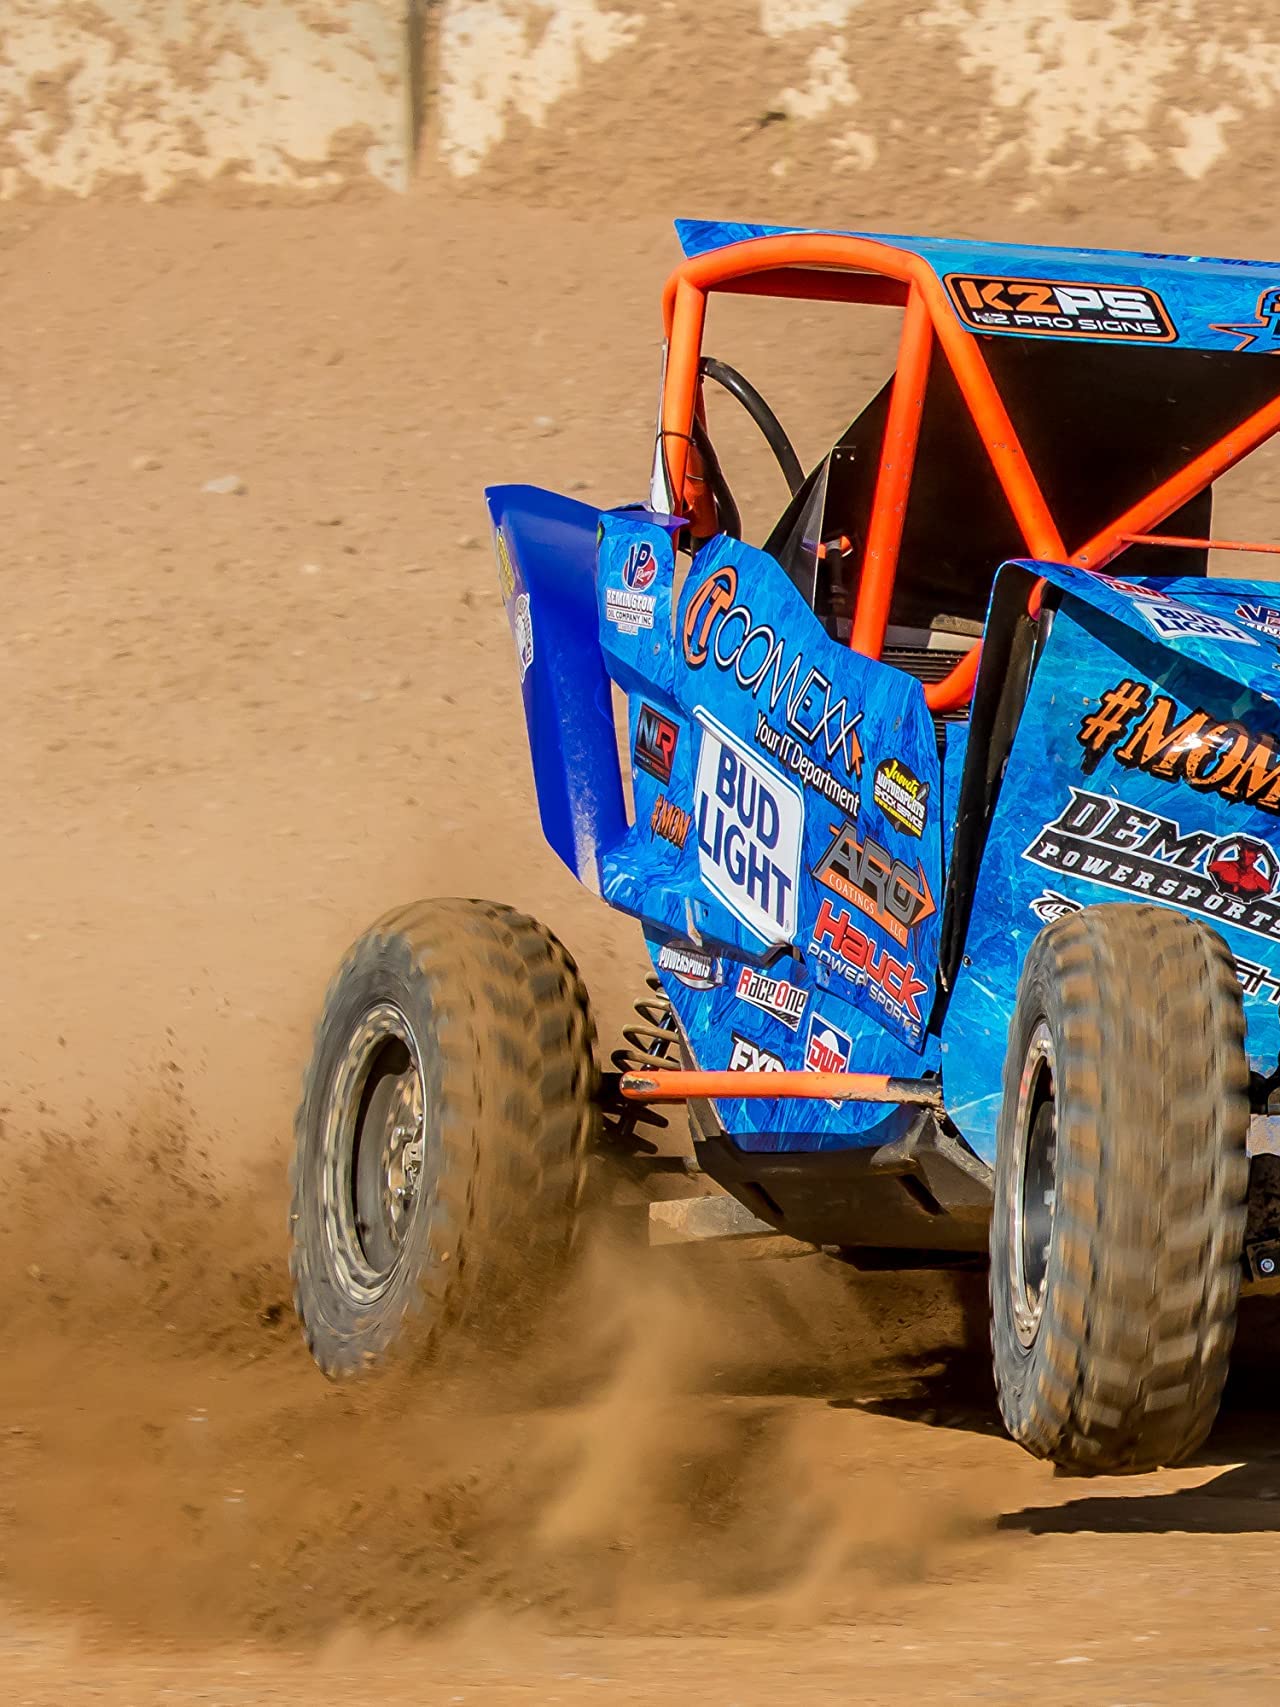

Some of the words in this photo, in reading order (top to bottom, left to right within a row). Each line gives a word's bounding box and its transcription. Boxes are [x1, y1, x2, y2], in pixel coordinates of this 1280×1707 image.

[959, 281, 1155, 320] K2PS
[1015, 314, 1073, 330] PRO
[1078, 319, 1162, 335] SIGNS
[627, 542, 652, 588] VP
[607, 589, 656, 612] REMINGTON
[616, 610, 641, 622] COMPANY
[1152, 607, 1221, 626] BUD
[1155, 618, 1246, 639] LIGHT
[638, 710, 677, 770] NLR
[755, 713, 780, 752] Your
[780, 734, 799, 762] IT
[793, 746, 860, 818] Department
[715, 744, 780, 850] BUD
[874, 784, 897, 809] SHOCK
[896, 801, 923, 831] SERVICE
[877, 770, 926, 820] MOTORSPORTS
[651, 794, 691, 850] #MOM
[700, 792, 792, 926] LIGHT
[828, 873, 875, 915] COATINGS
[889, 918, 903, 940] LLC
[737, 967, 808, 1015] RaceOne
[806, 941, 867, 987] POWER
[868, 982, 922, 1038] SPORTS
